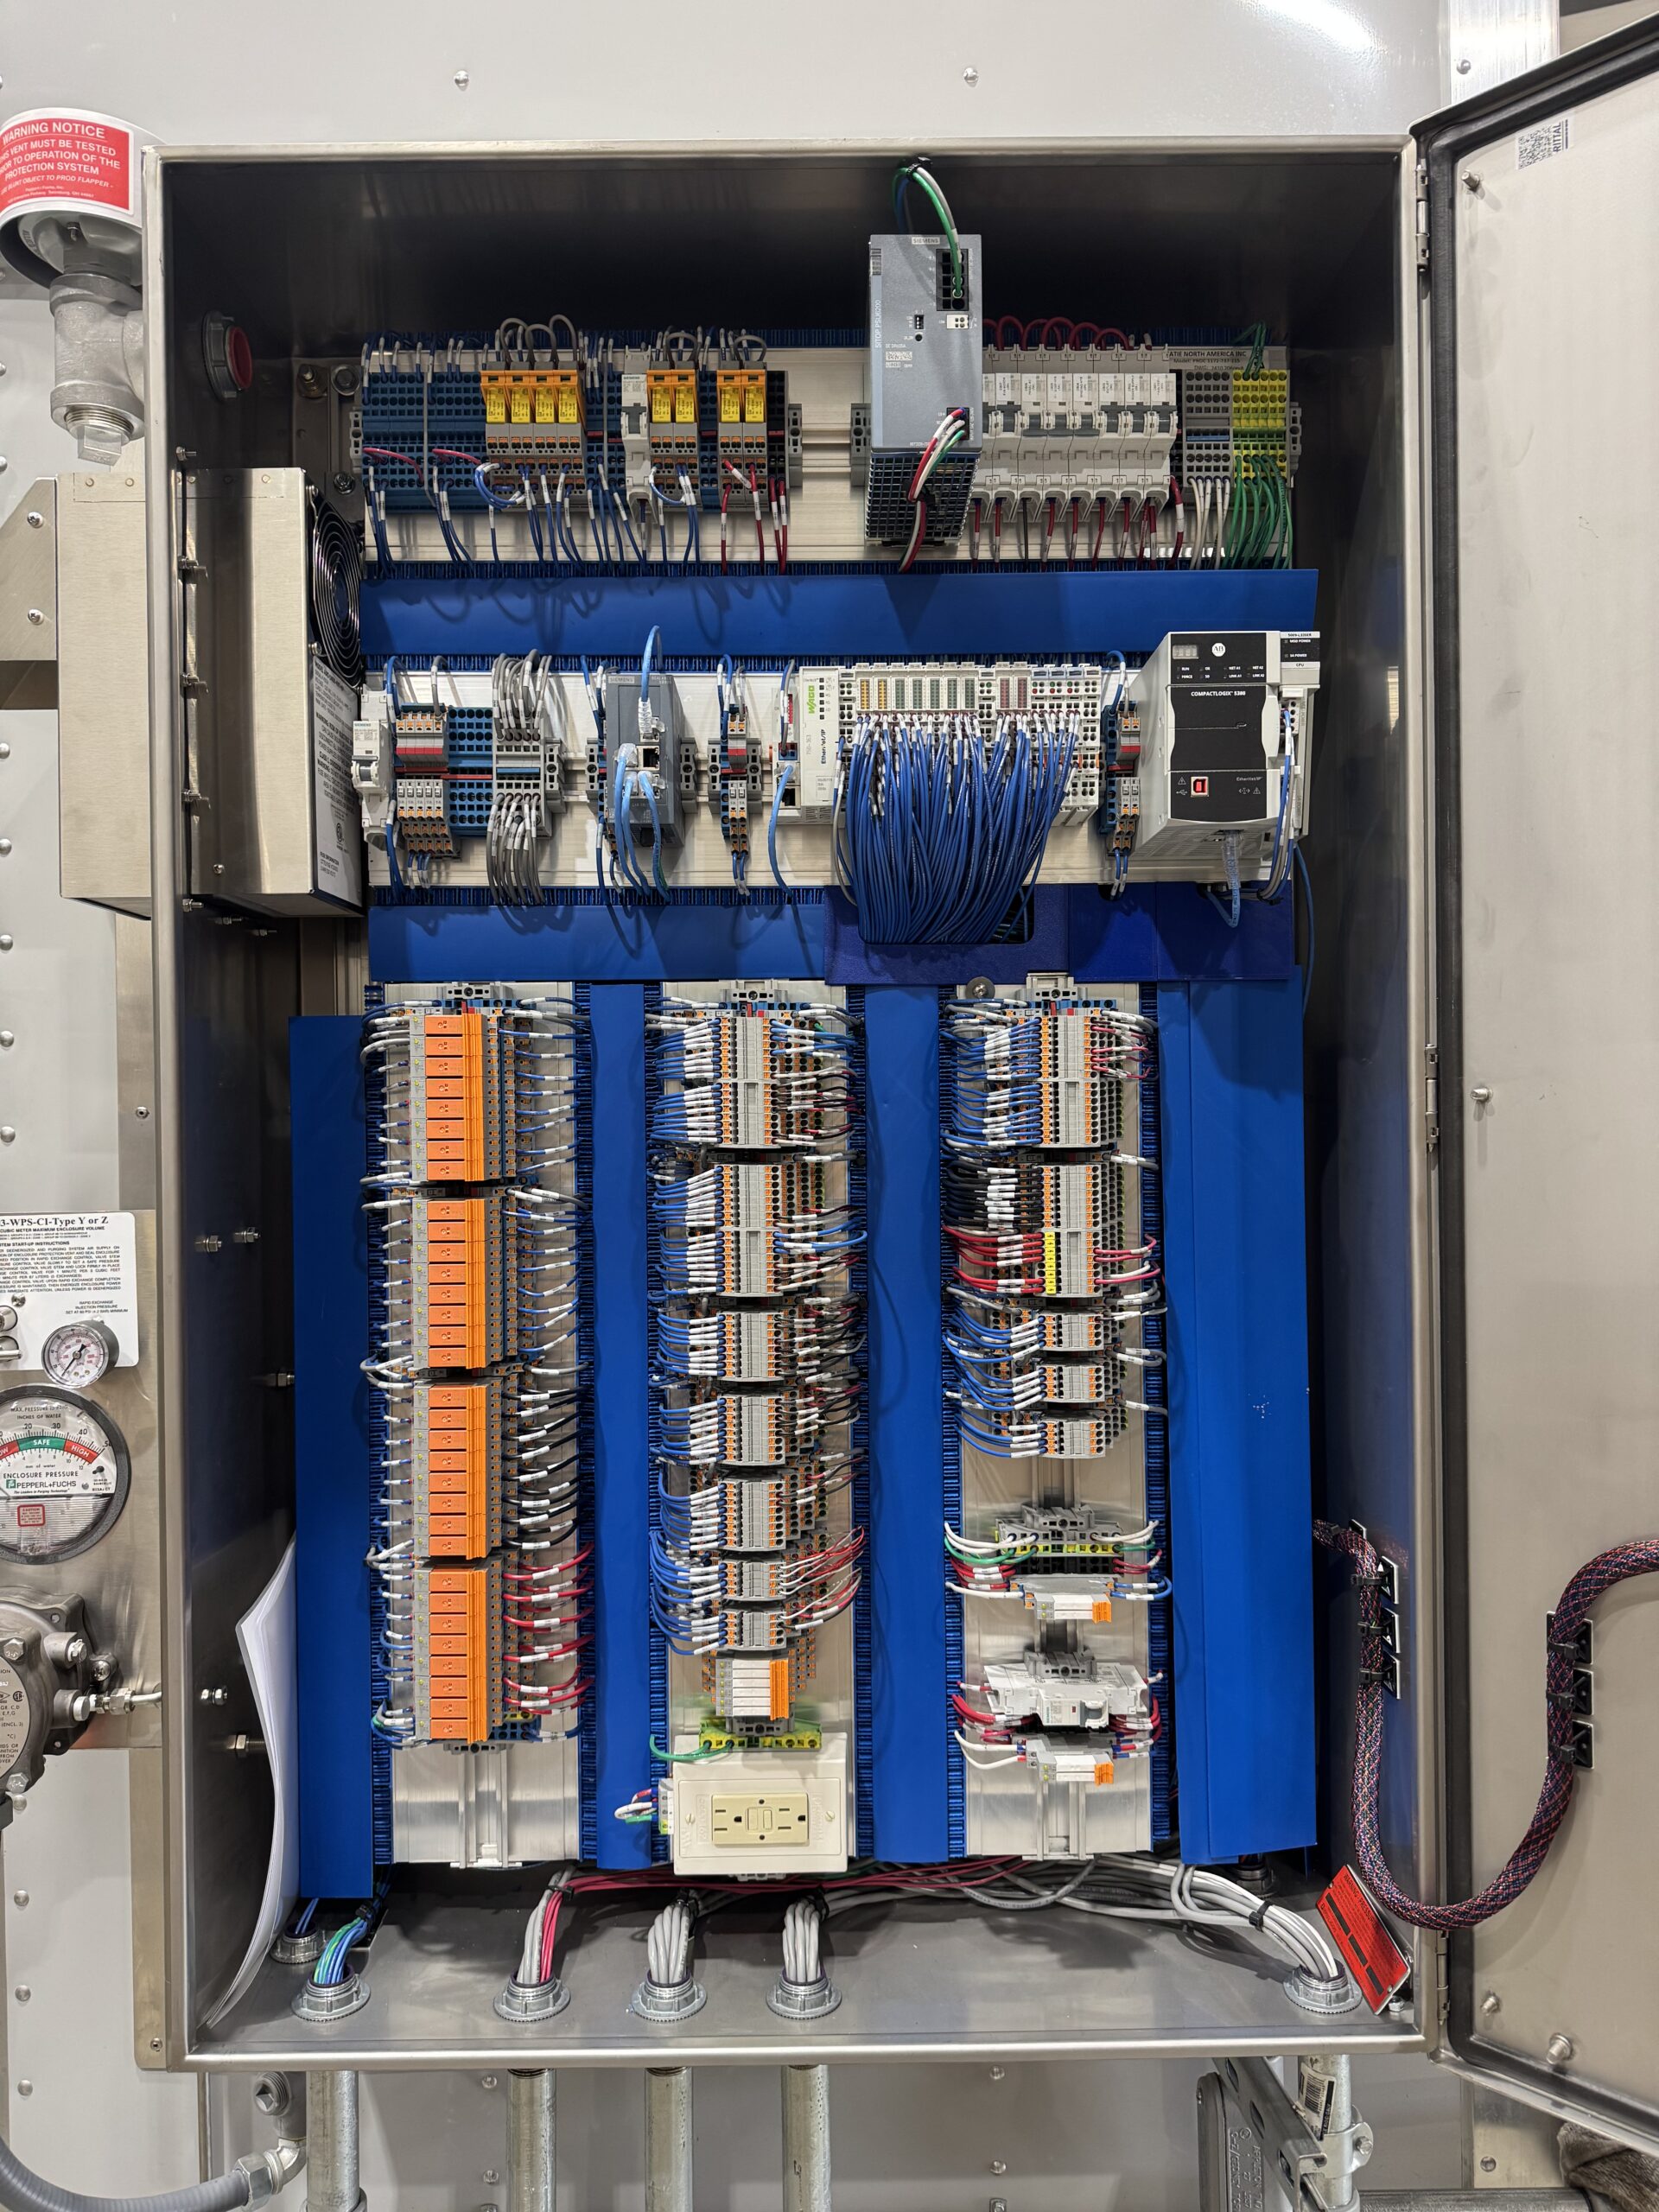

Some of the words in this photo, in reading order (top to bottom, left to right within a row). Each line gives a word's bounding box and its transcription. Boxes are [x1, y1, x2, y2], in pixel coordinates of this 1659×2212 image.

[2, 123, 48, 145] WARNING
[53, 122, 105, 138] NOTICE
[1552, 122, 1561, 152] RITTAL
[11, 143, 28, 155] VENT
[31, 139, 56, 149] MUST
[59, 140, 72, 148] BE
[75, 140, 116, 156] TESTED
[13, 156, 22, 165] TO
[25, 151, 78, 161] OPERATION
[82, 154, 96, 162] OF
[99, 157, 120, 169] THE
[5, 163, 54, 181] PROTECTION
[57, 162, 99, 175] SYSTEM
[23, 175, 44, 184] OBJECT
[78, 176, 109, 187] FLAPPER
[807, 685, 816, 714] WAGO
[0, 1217, 75, 1227] 3-WPS-CI-Type
[71, 1445, 89, 1457] HIGH
[1343, 1874, 1359, 1897] WARNING
